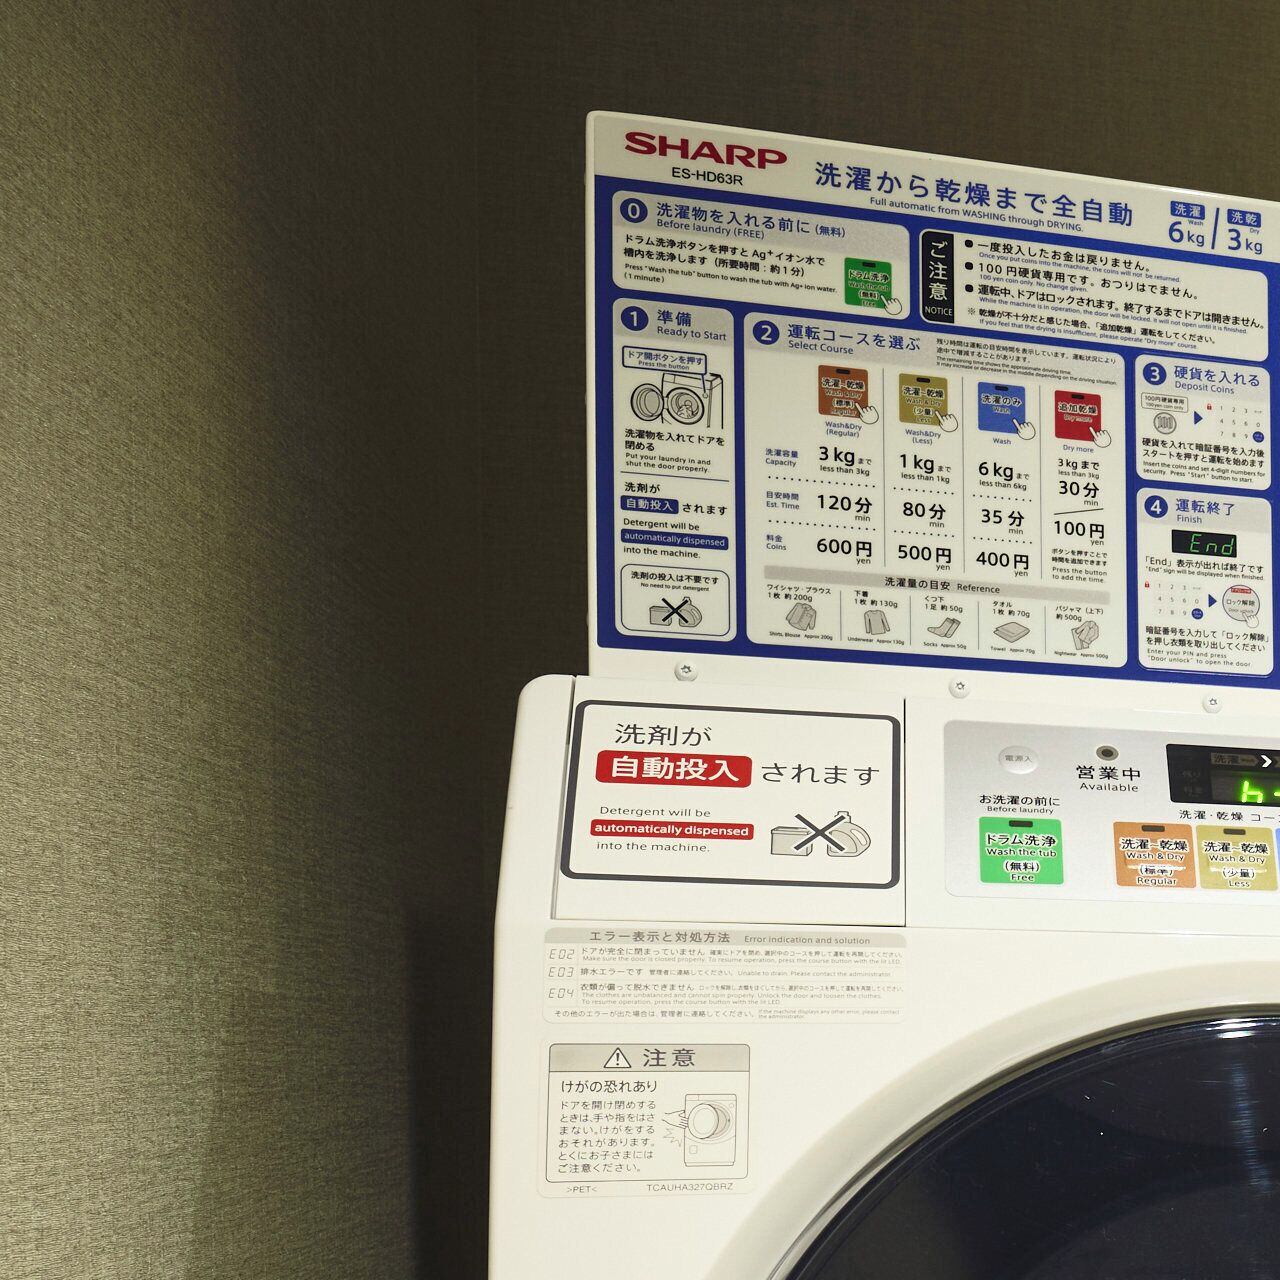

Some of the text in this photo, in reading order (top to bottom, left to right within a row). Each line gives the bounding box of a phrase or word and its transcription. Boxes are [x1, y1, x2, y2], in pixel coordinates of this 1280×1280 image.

[624, 131, 787, 170] SHARP
[672, 167, 743, 185] ES-HD63R
[815, 161, 1133, 228] 洗濯から乾燥まで全自動
[656, 202, 809, 234] 洗濯物を入れる前に
[977, 242, 1151, 272] 一度投入したお金は戻りません。
[928, 240, 948, 301] ご注意
[924, 305, 952, 316] NOTICE
[657, 310, 692, 326] 準備
[657, 326, 726, 341] Ready to Start
[788, 323, 920, 352] 運転コースを選ぶ
[788, 340, 853, 355] Select Course
[1174, 366, 1260, 387] 硬貨を入れる
[1175, 381, 1234, 394] Deposit Coins
[625, 429, 724, 446] 洗濯物を入れてドアを
[625, 441, 655, 451] 閉める
[766, 458, 796, 468] Capacity
[1143, 449, 1264, 468] スタートを押すと運転を始めます
[625, 481, 660, 494] 洗剤が
[626, 498, 728, 516] 自動投入 されます
[1176, 498, 1235, 515] 運転終了
[1177, 515, 1202, 524] Finish
[624, 532, 725, 549] automatically dispensed
[1190, 534, 1233, 555] End
[631, 571, 718, 585] 洗剤の投入は不要です
[885, 577, 950, 591] 洗濯量の目安
[957, 583, 1000, 594] Reference
[614, 723, 712, 747] 洗剤が
[611, 756, 879, 785] 自動投入 されます
[1076, 765, 1141, 781] 営業中
[1080, 782, 1139, 793] Available
[980, 795, 1061, 807] お洗濯の前に
[600, 806, 711, 817] Detergent will be
[595, 824, 749, 837] automatically dispensed
[597, 841, 709, 852] into the machine.
[985, 833, 1057, 847] ドラム洗浄
[1011, 873, 1034, 883] Free
[1137, 876, 1176, 887] Regular
[1229, 878, 1250, 888] Less
[590, 931, 730, 944] エラー表示と対処方法
[549, 949, 574, 960] E02
[549, 967, 573, 978] E03
[549, 988, 573, 999] E04
[643, 1048, 696, 1067] 注意
[560, 1080, 658, 1093] けがの恐れあり
[560, 1100, 656, 1110] ドアを開け閉めする
[558, 1138, 655, 1148] おそれがあります。
[558, 1150, 654, 1161] とくにお子さまには
[558, 1163, 641, 1173] ご注意ください。
